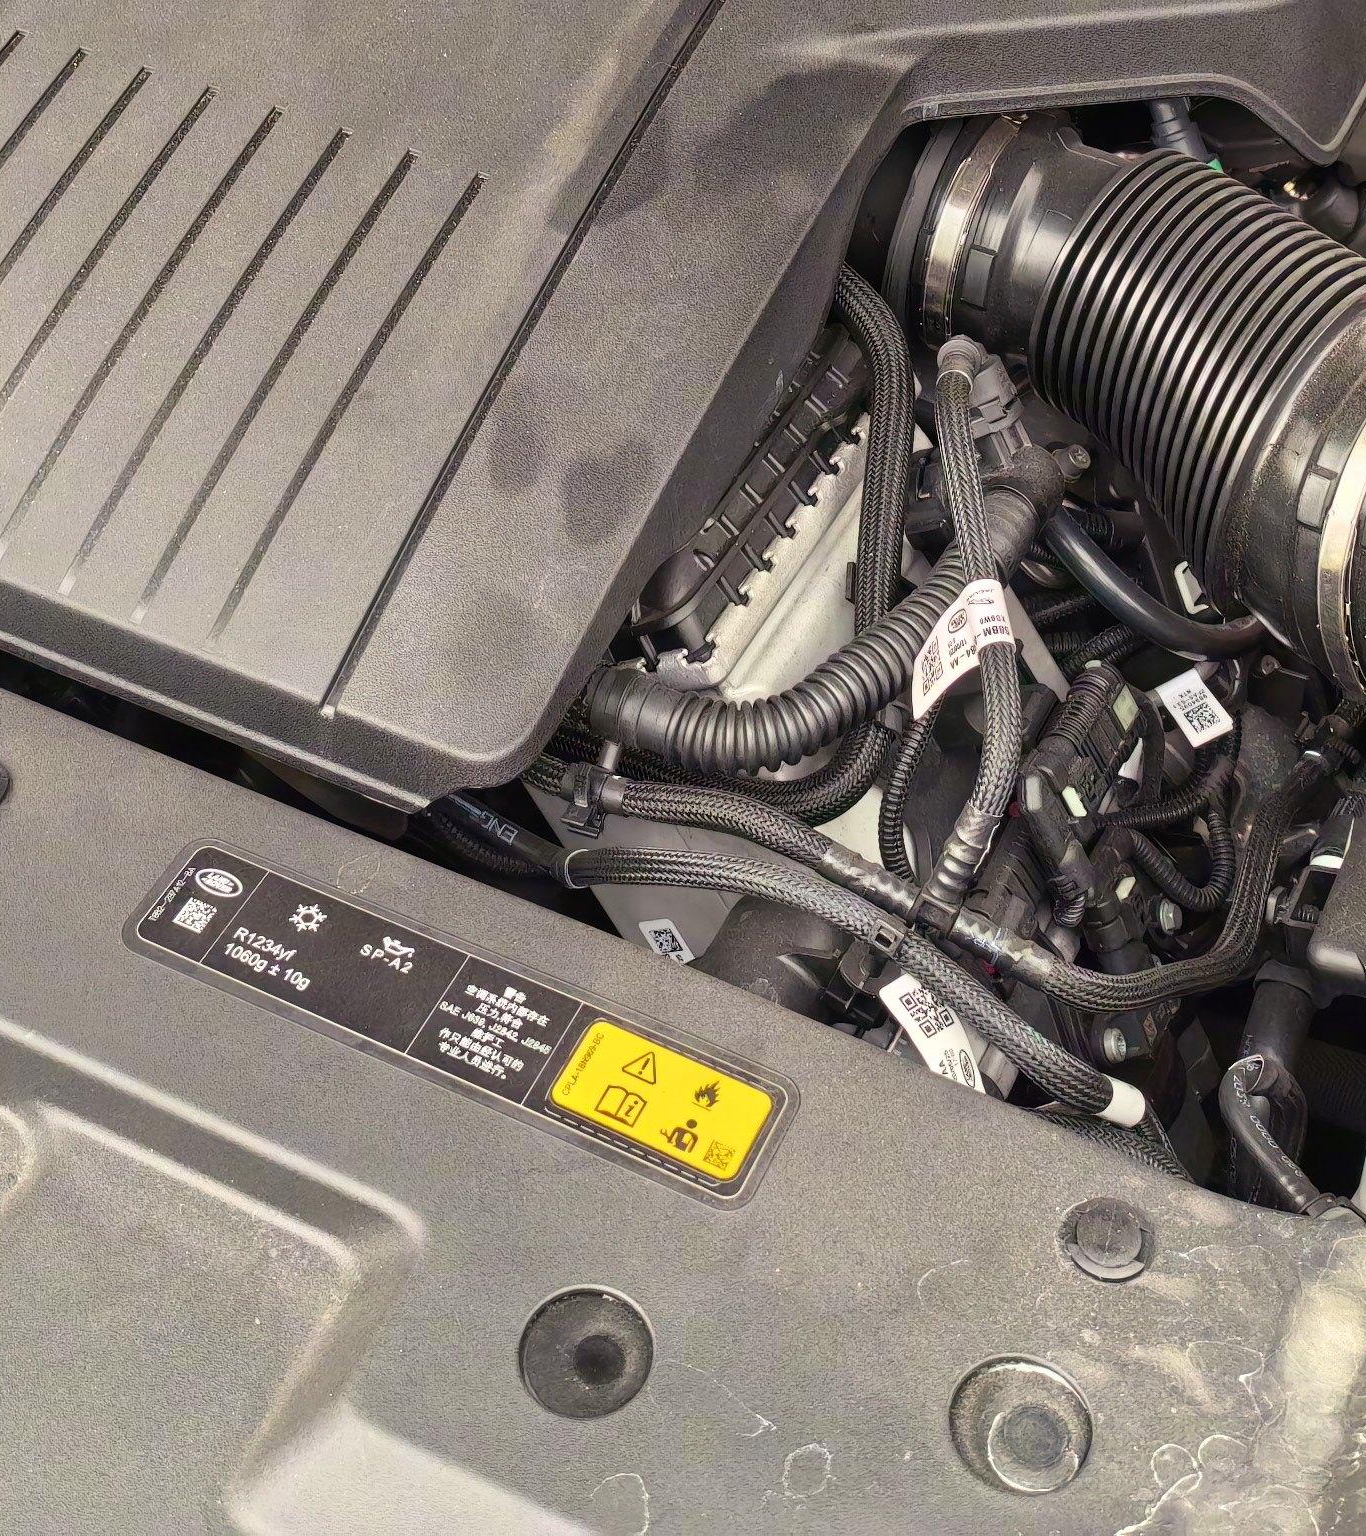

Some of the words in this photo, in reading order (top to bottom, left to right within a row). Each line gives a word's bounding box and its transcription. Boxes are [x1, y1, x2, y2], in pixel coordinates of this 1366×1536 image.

[233, 926, 297, 963] R1234yf
[360, 944, 413, 974] SP-A2
[225, 943, 269, 973] 1060g
[268, 964, 280, 977] ±
[284, 967, 311, 992] 10g
[439, 1001, 463, 1017] SAE
[464, 984, 551, 1028] 空调系统内部存在
